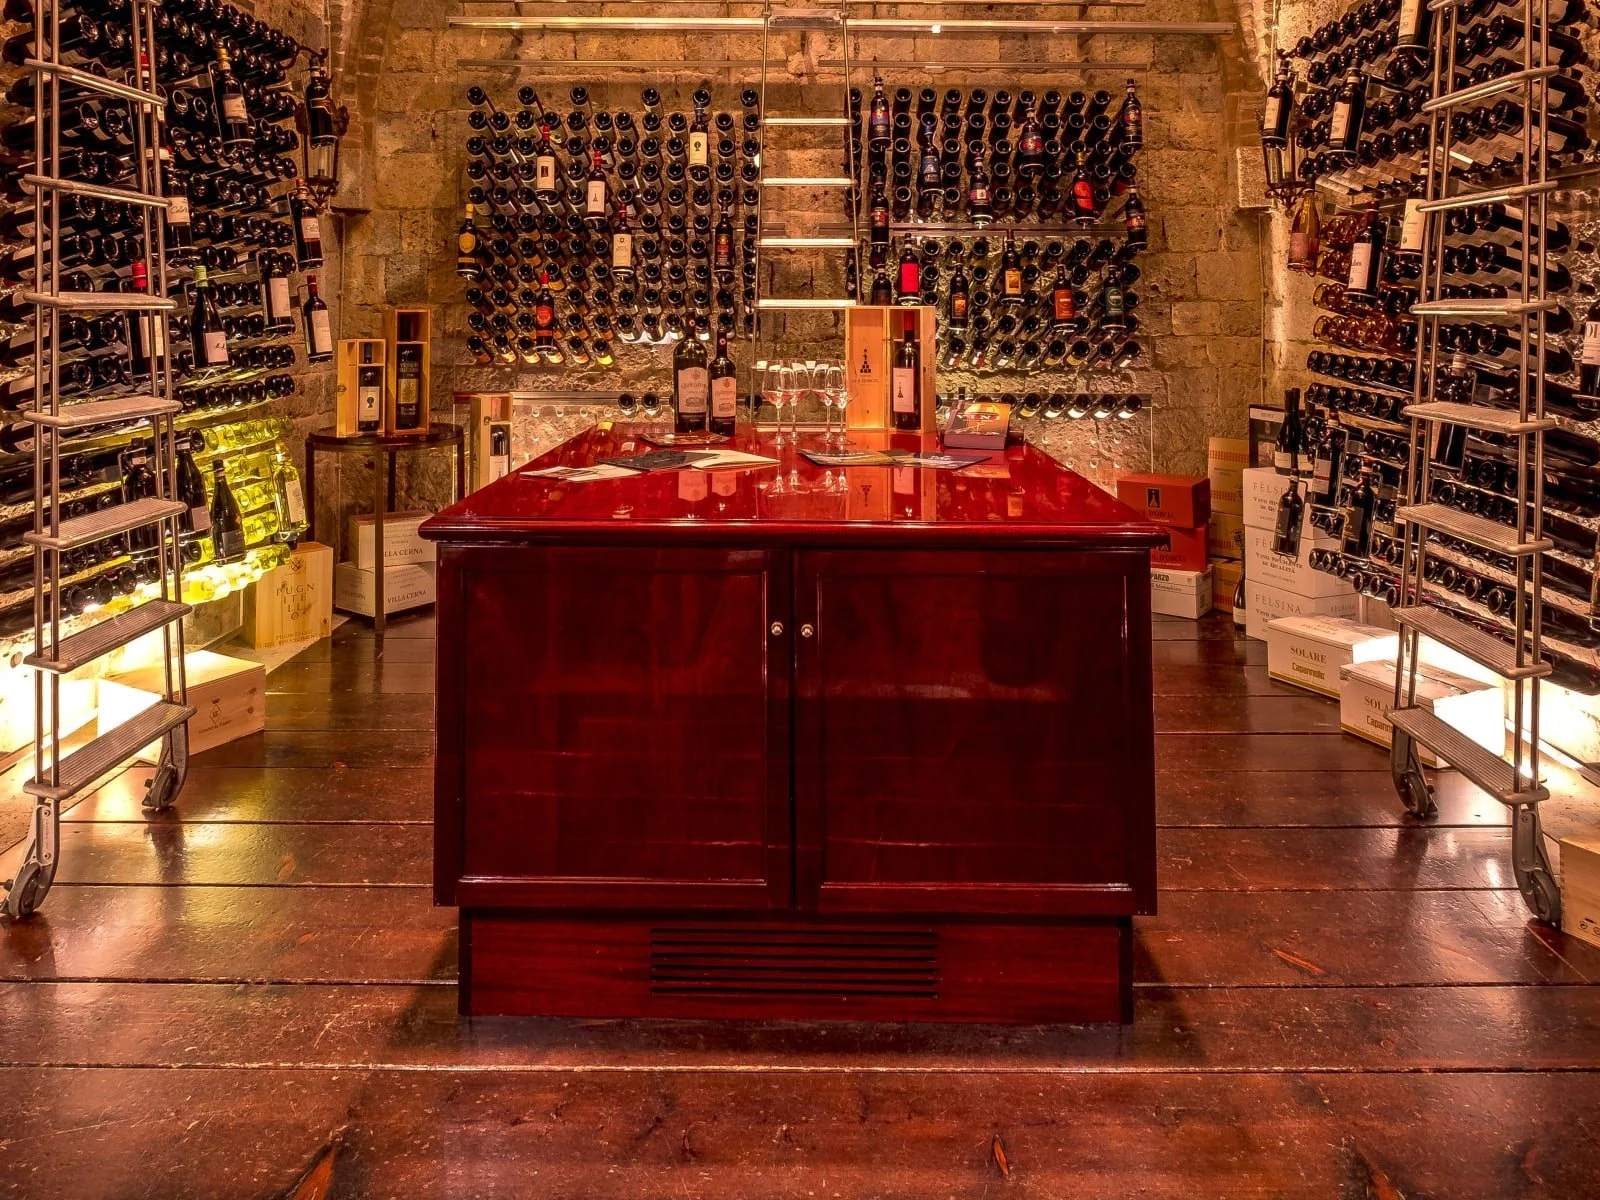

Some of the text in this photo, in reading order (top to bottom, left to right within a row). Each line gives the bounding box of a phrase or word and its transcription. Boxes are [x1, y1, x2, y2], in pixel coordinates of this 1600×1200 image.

[956, 413, 1001, 421] VINI
[1253, 481, 1288, 495] FÈLSI
[399, 548, 424, 556] CERNA
[1151, 573, 1170, 582] PARZO
[387, 589, 427, 604] VILLA CERNA
[1255, 593, 1302, 615] FÈLSINA
[1290, 645, 1327, 664] SOLARE
[1364, 695, 1393, 712] SOLA
